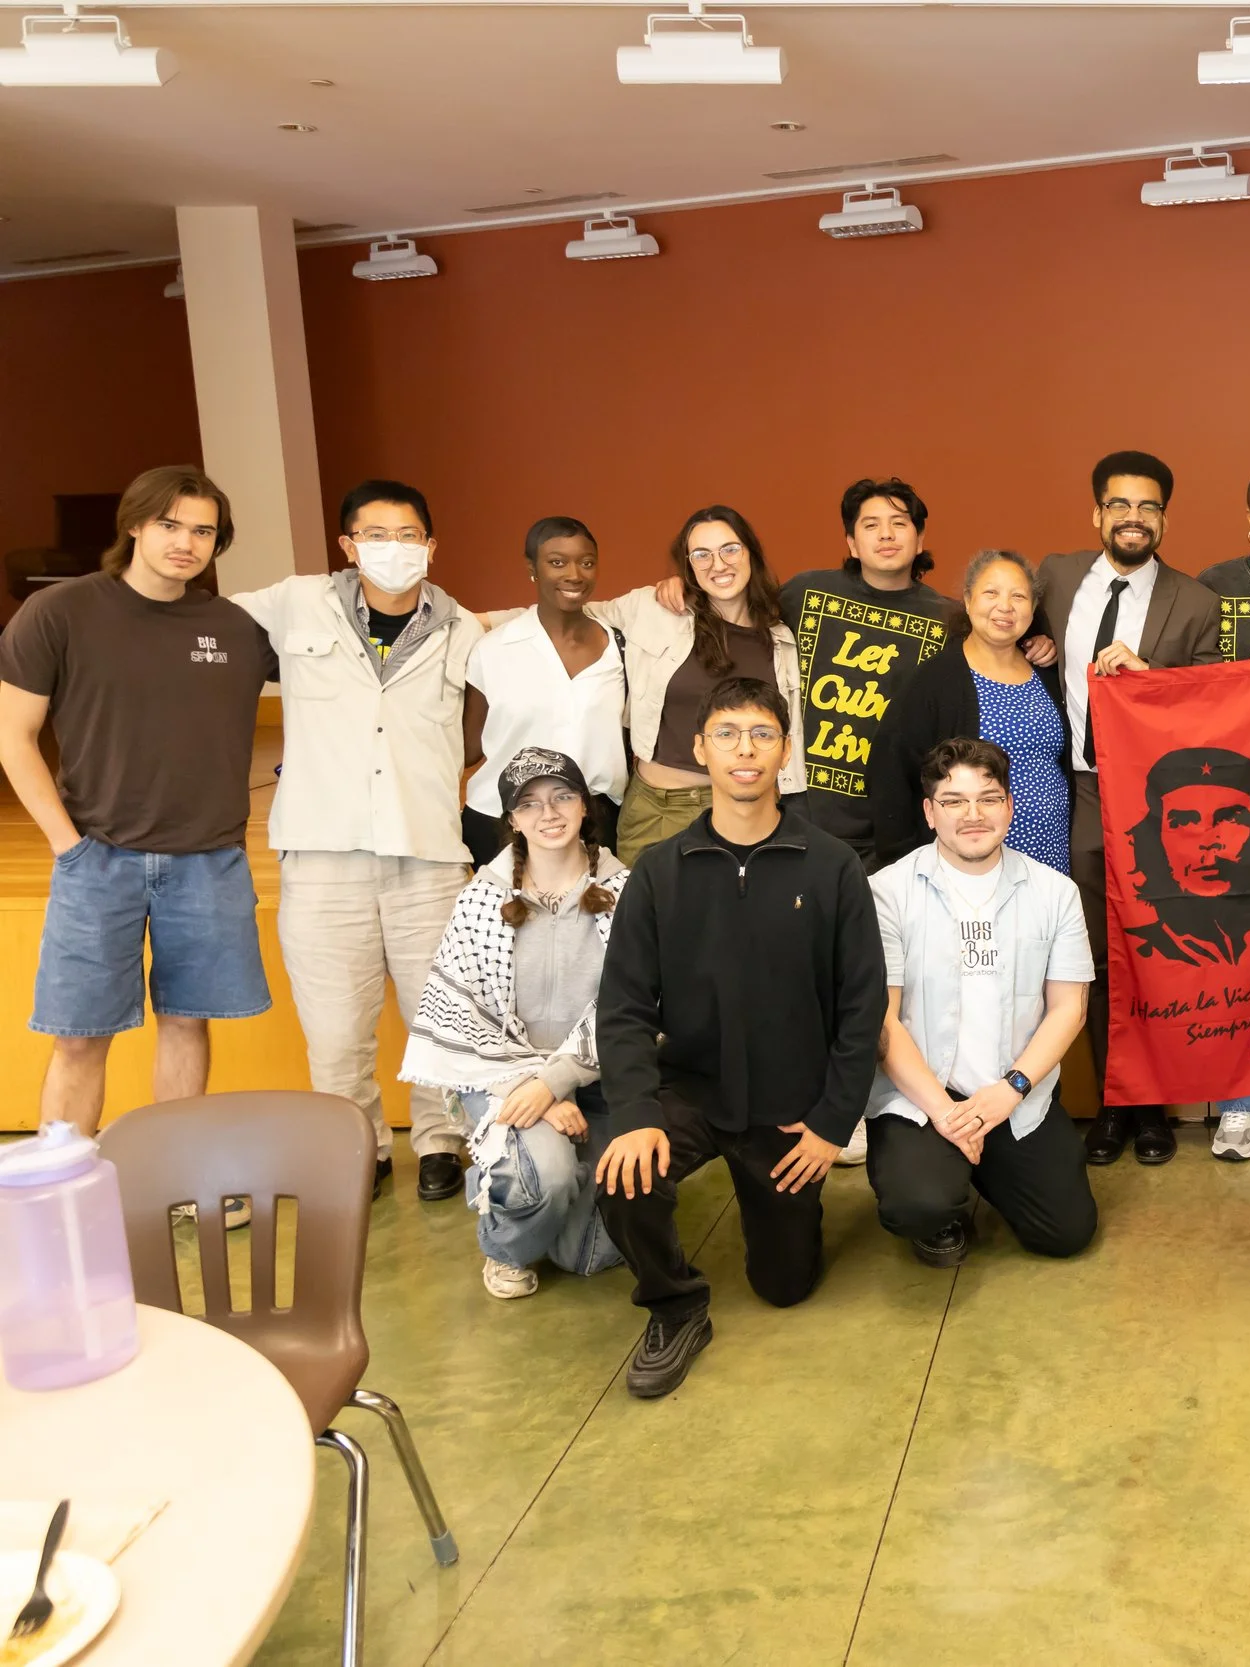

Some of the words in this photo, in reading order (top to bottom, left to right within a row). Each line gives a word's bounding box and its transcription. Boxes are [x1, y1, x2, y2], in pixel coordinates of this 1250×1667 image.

[197, 636, 217, 649] BIG
[832, 631, 899, 674] Let
[191, 650, 228, 663] SPOON
[807, 720, 871, 765] Liv
[961, 921, 992, 940] ues
[963, 940, 998, 968] Bar
[1195, 990, 1219, 1010] la
